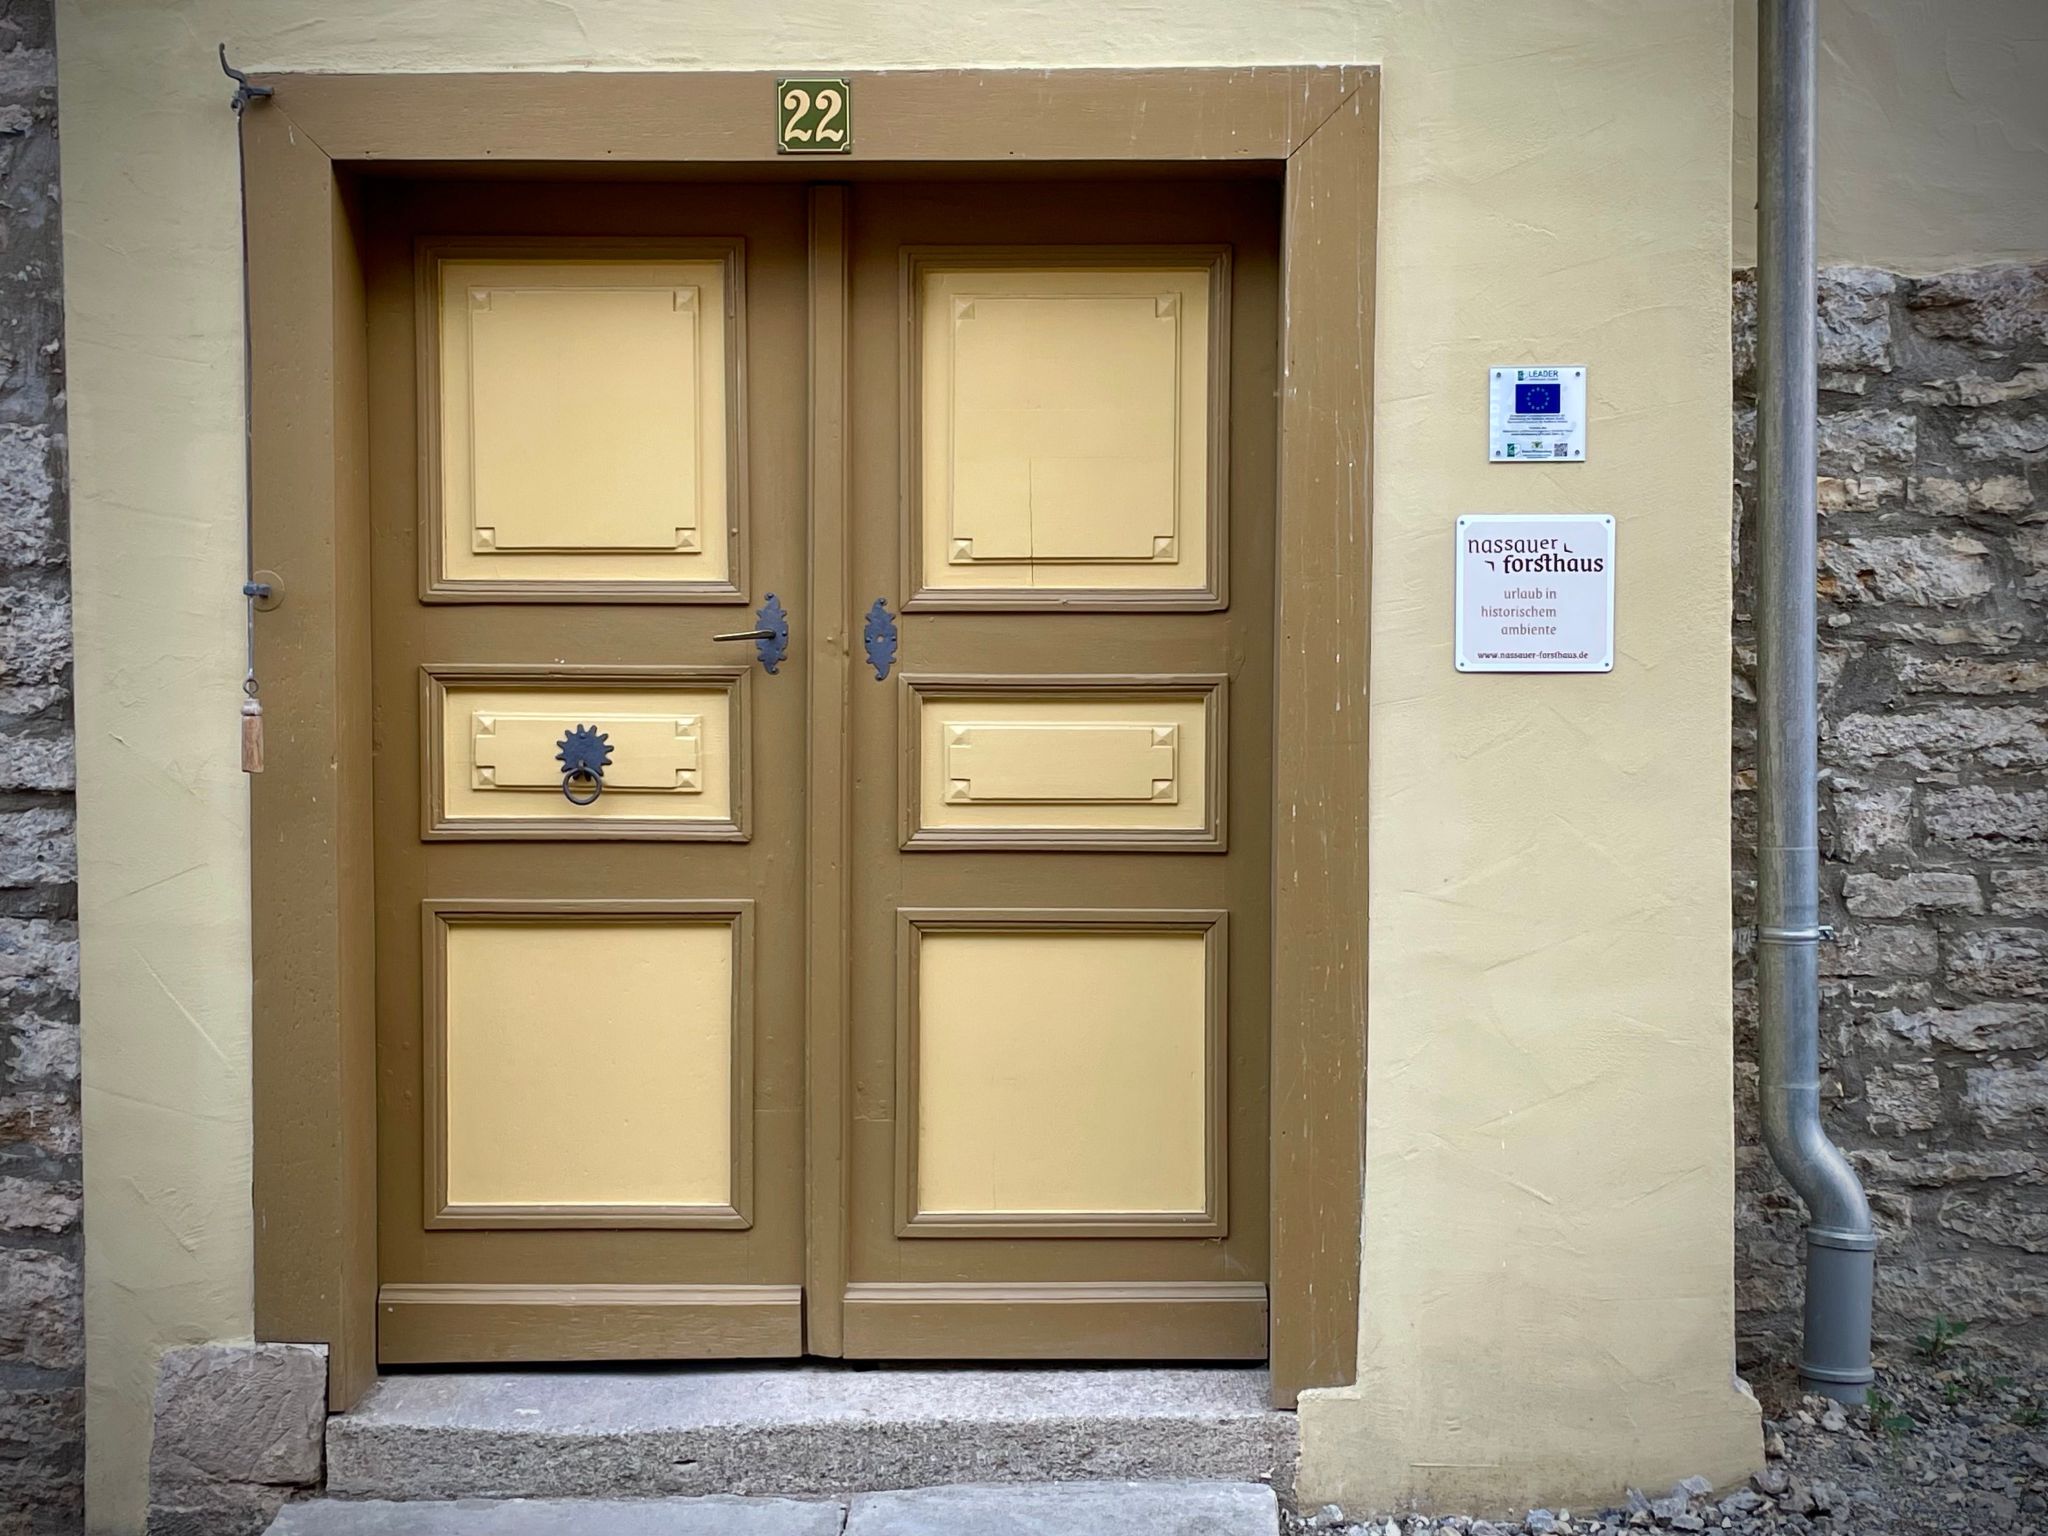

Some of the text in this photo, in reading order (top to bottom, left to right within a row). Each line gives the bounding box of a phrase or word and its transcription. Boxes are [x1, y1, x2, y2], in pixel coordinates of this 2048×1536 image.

[784, 89, 844, 142] 22
[1528, 370, 1559, 378] LEADER
[1468, 538, 1558, 554] nassauer
[1503, 553, 1604, 574] forsthaus
[1504, 587, 1557, 600] urlaub in
[1481, 606, 1557, 618] historischem
[1501, 623, 1557, 635] ambiente
[1477, 650, 1589, 660] www.nassauer-forsthaus.de
